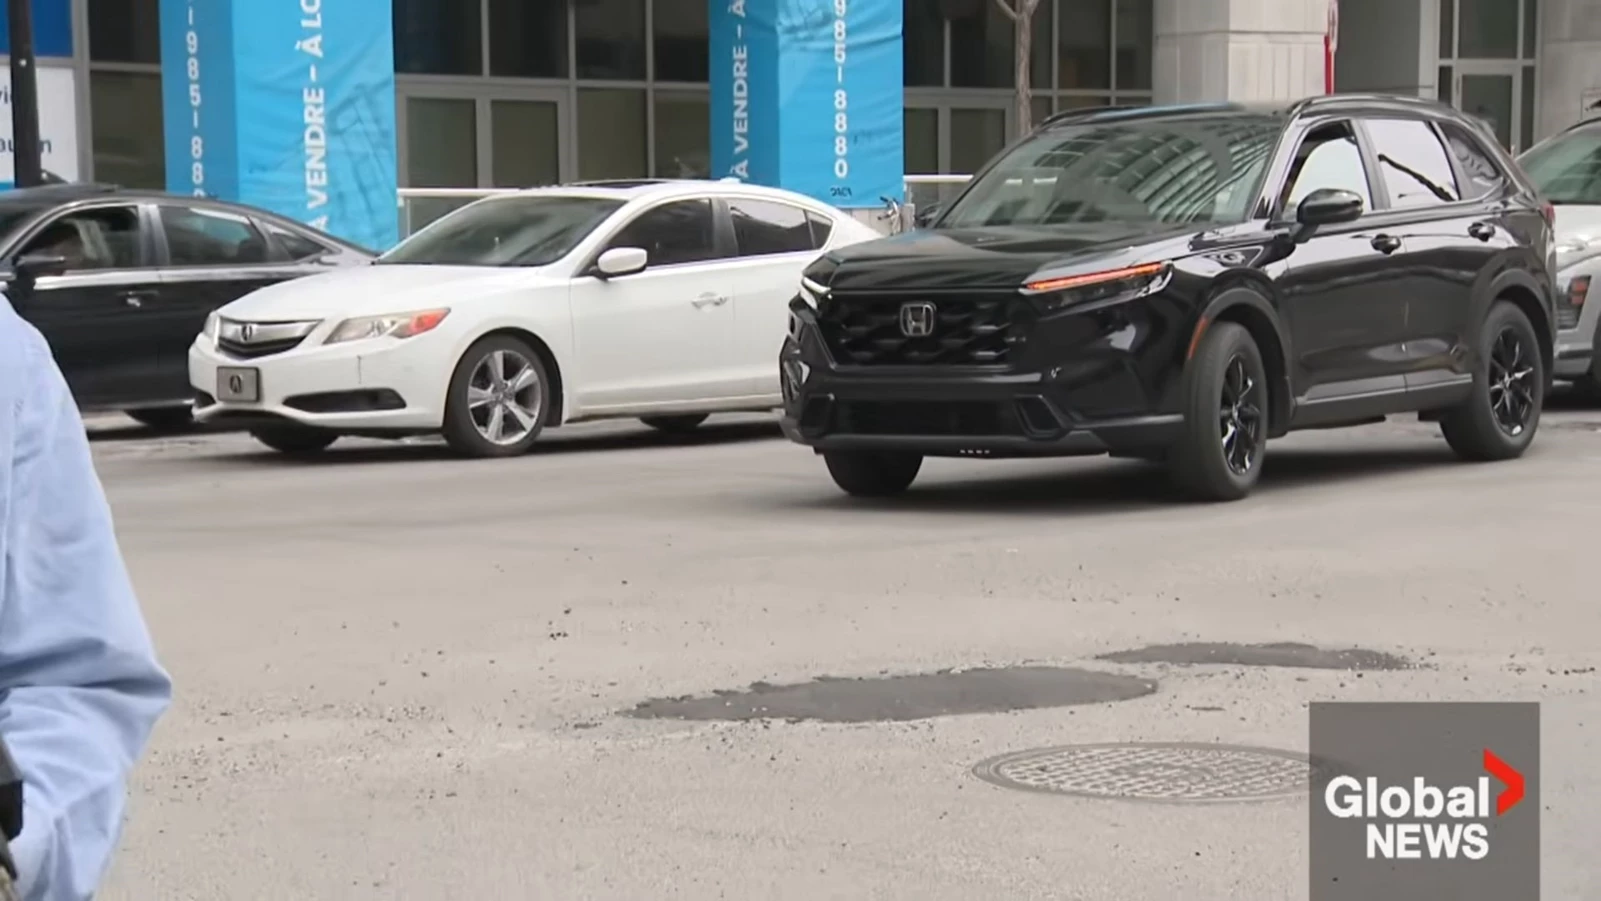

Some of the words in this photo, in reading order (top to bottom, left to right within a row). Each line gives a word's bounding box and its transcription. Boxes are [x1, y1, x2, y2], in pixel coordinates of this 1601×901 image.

[294, 34, 324, 58] À
[732, 45, 749, 154] VENDRE
[303, 87, 328, 209] VENDRE
